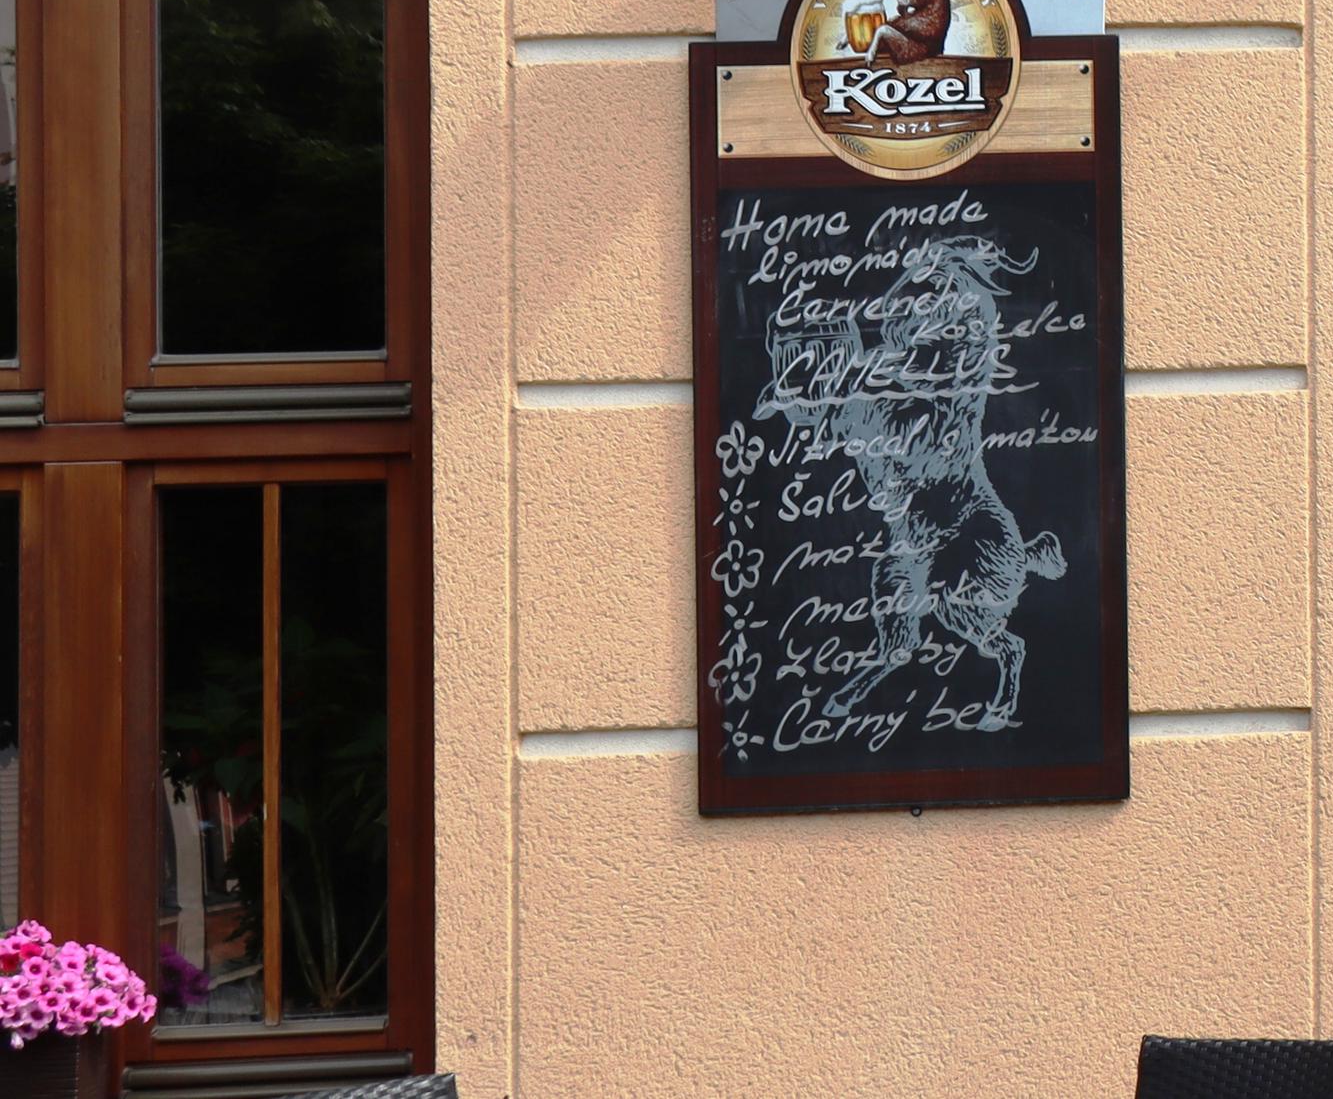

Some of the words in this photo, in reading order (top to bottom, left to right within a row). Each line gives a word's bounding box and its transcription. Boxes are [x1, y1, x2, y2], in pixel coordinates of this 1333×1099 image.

[823, 68, 986, 116] Kozel
[884, 122, 932, 134] 1874
[721, 198, 850, 251] Home
[865, 189, 988, 246] made
[773, 684, 917, 752] Černý
